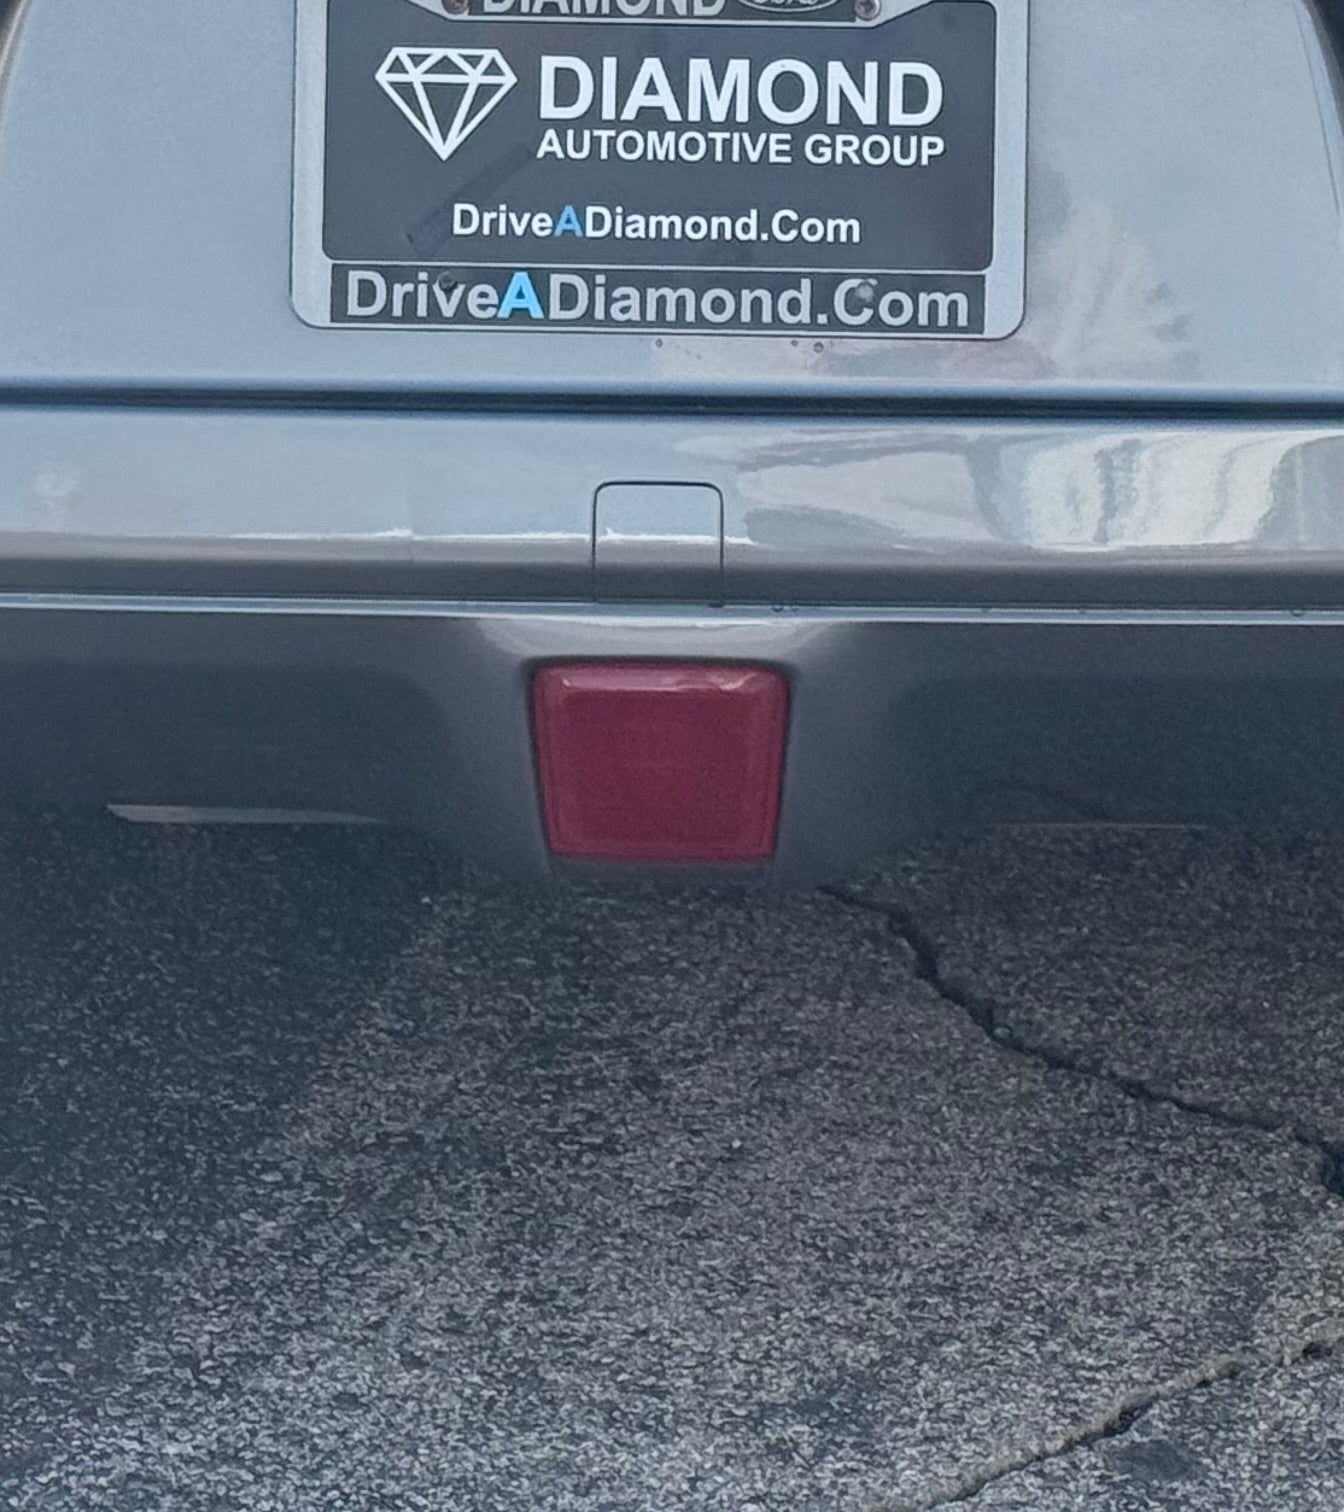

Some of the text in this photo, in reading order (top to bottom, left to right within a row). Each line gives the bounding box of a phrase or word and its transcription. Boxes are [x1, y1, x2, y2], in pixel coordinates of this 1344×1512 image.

[539, 56, 944, 126] DIAMOND
[537, 129, 944, 166] AUTOMOTIVE GROUP
[454, 204, 862, 244] DriveADiamond.Com
[346, 271, 970, 328] DriveADiamond.Com
